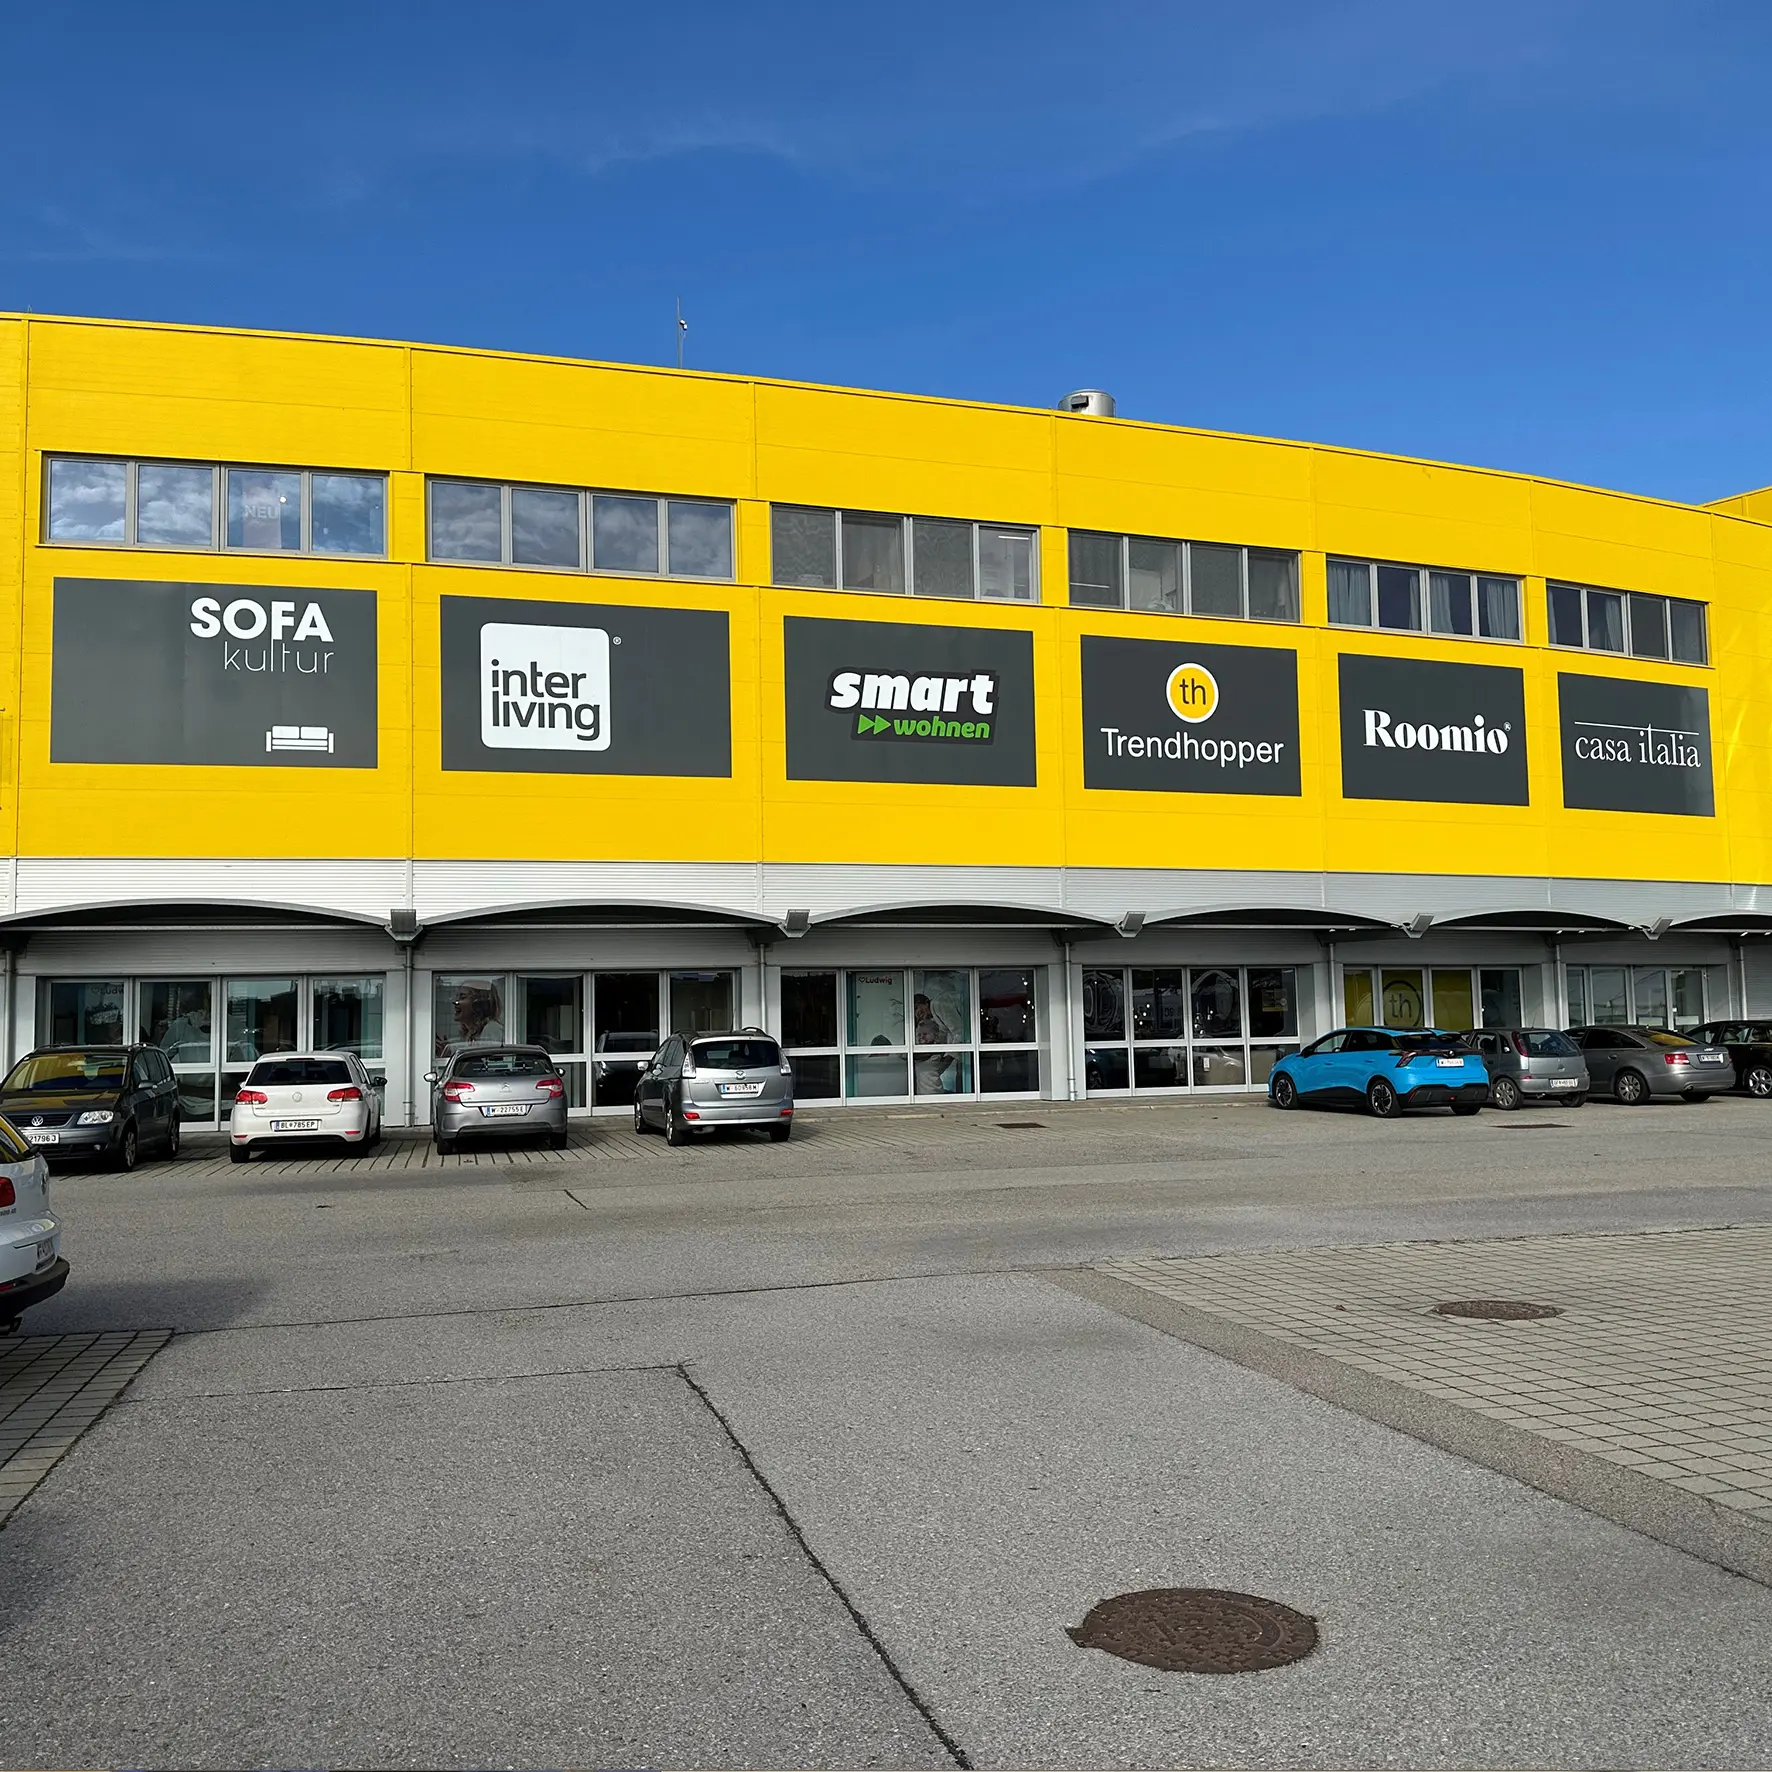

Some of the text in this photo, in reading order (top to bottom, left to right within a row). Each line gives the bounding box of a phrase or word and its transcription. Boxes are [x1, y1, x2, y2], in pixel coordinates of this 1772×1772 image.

[244, 505, 279, 519] NEU
[190, 597, 334, 642] SOFA
[224, 640, 334, 674] kultur
[491, 658, 587, 699] inter
[830, 672, 994, 715] smart
[1178, 677, 1207, 706] th
[492, 690, 601, 742] living
[893, 715, 990, 739] wohnen
[1100, 727, 1285, 769] Trendhopper
[1575, 723, 1702, 768] casa italia
[865, 976, 893, 986] Ludwig
[1389, 993, 1413, 1019] th
